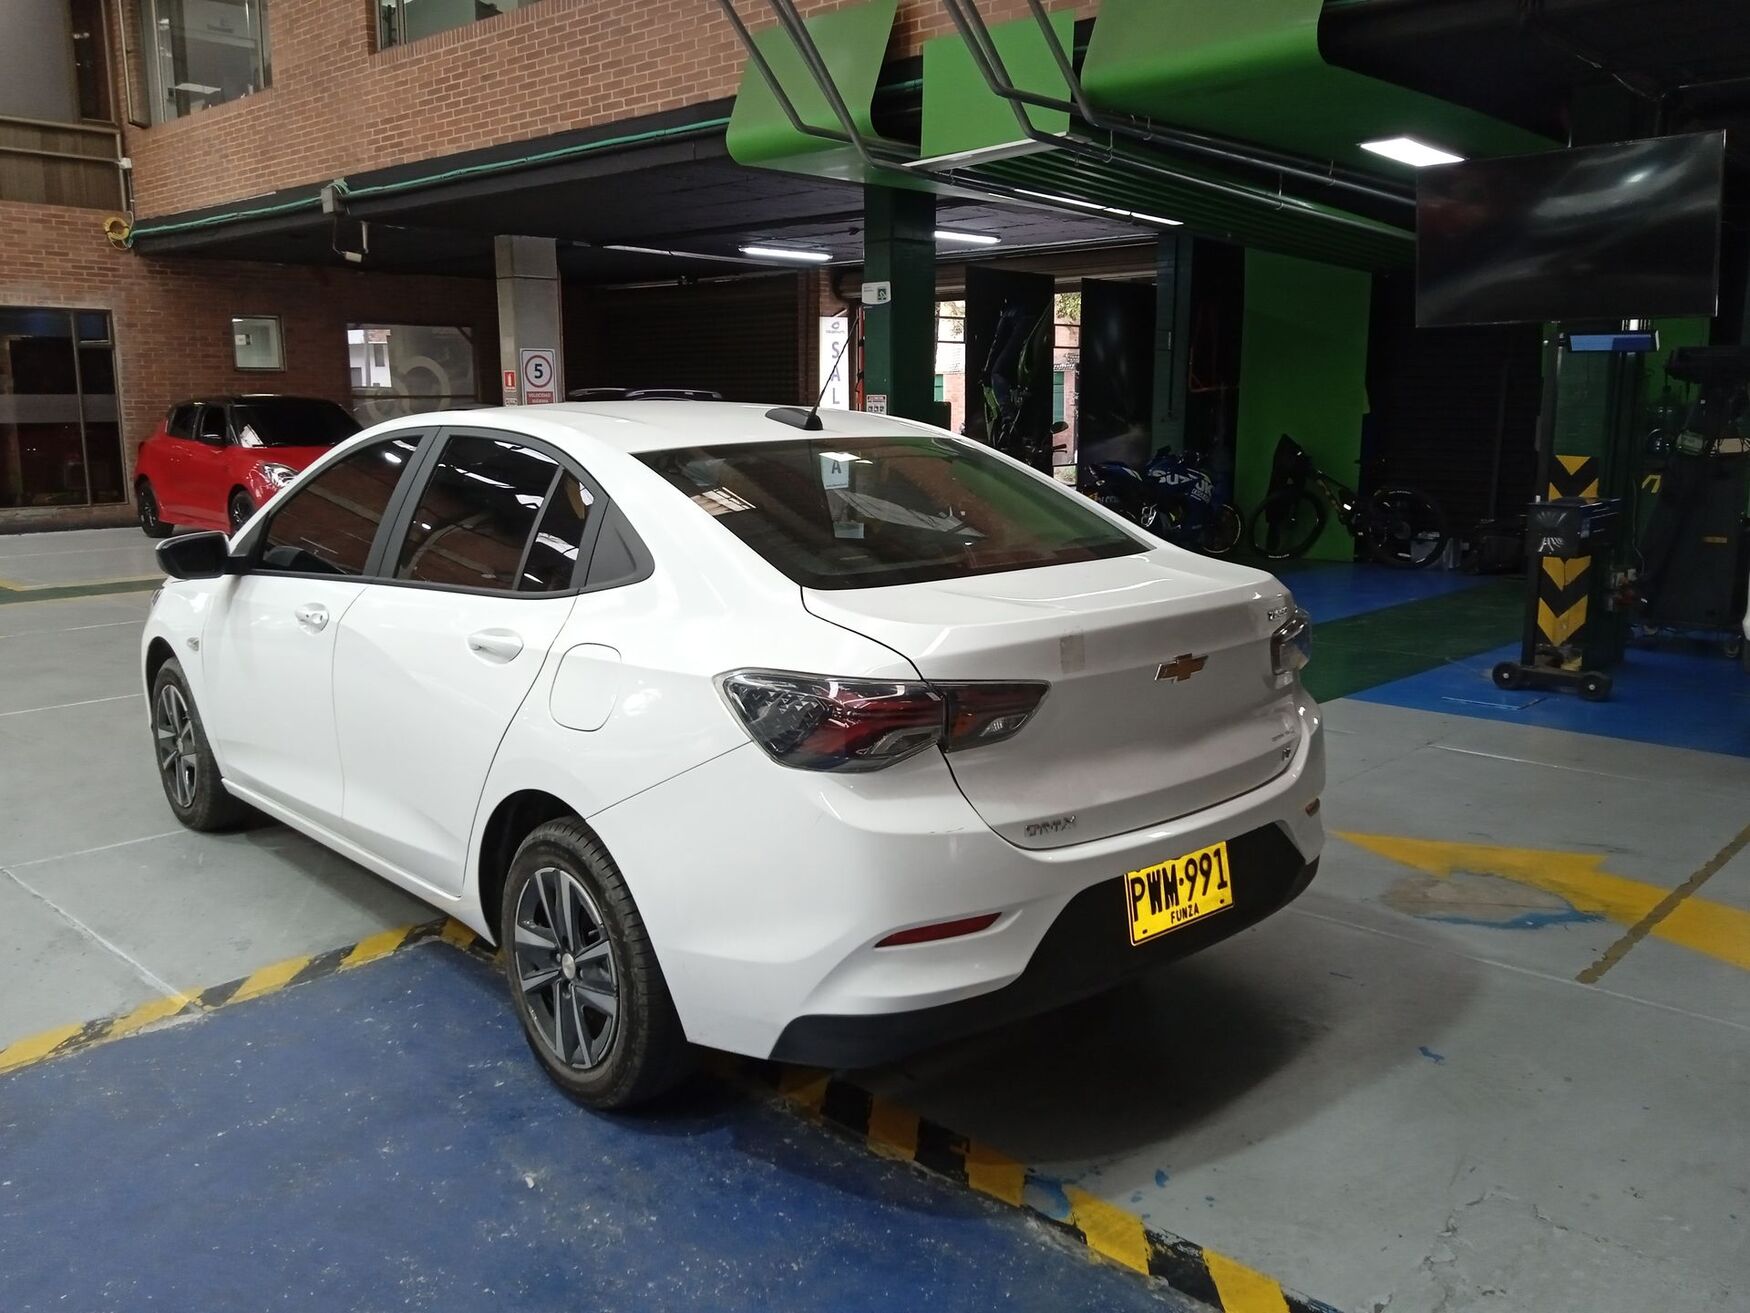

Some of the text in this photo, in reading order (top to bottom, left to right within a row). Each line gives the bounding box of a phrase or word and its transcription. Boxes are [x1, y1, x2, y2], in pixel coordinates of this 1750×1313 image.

[534, 363, 544, 379] 5
[1149, 469, 1215, 497] SUZUK
[1170, 902, 1200, 924] FUNZA
